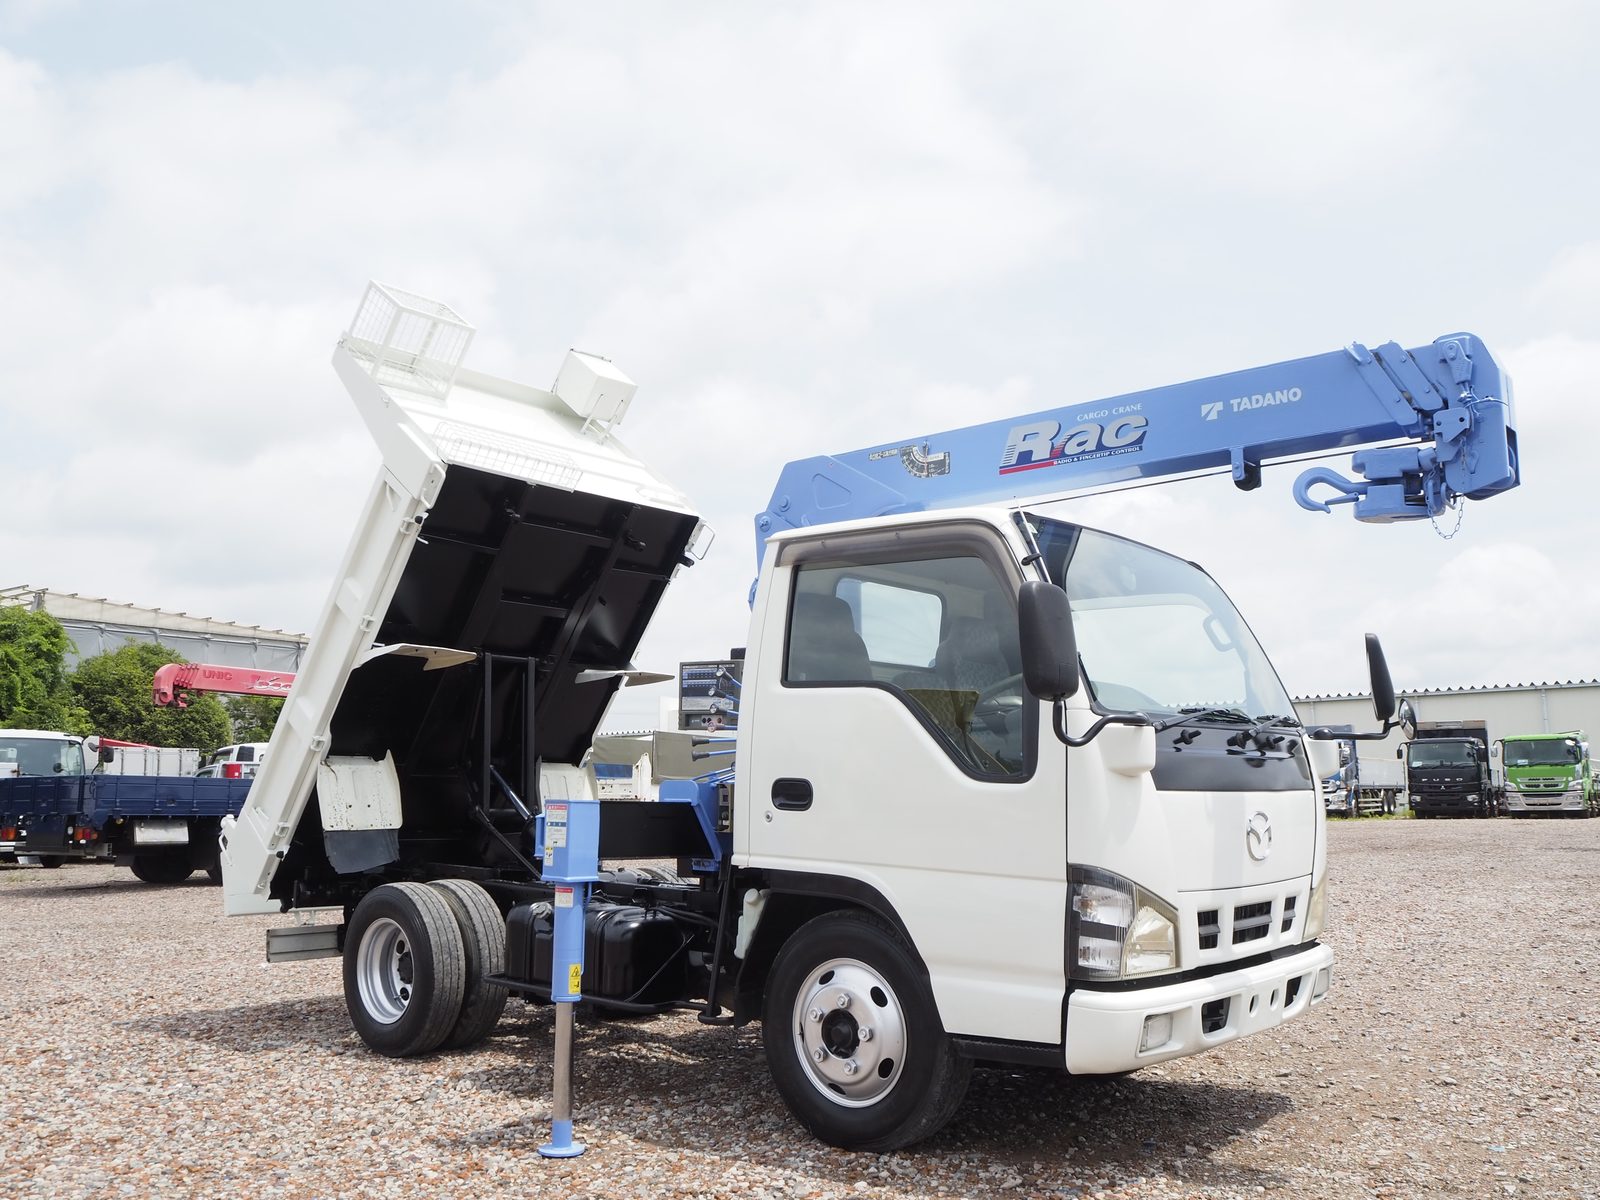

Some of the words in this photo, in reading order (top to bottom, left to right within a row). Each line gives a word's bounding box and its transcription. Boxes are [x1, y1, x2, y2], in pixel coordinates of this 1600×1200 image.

[1230, 387, 1302, 412] TADANO
[1077, 410, 1108, 422] CARGO
[1112, 403, 1143, 415] CRANE
[1001, 415, 1149, 467] Rac
[1053, 457, 1072, 466] RADIO
[1079, 452, 1110, 461] FINGERTIP
[1111, 447, 1141, 456] CONTROL
[203, 669, 233, 681] UNIC
